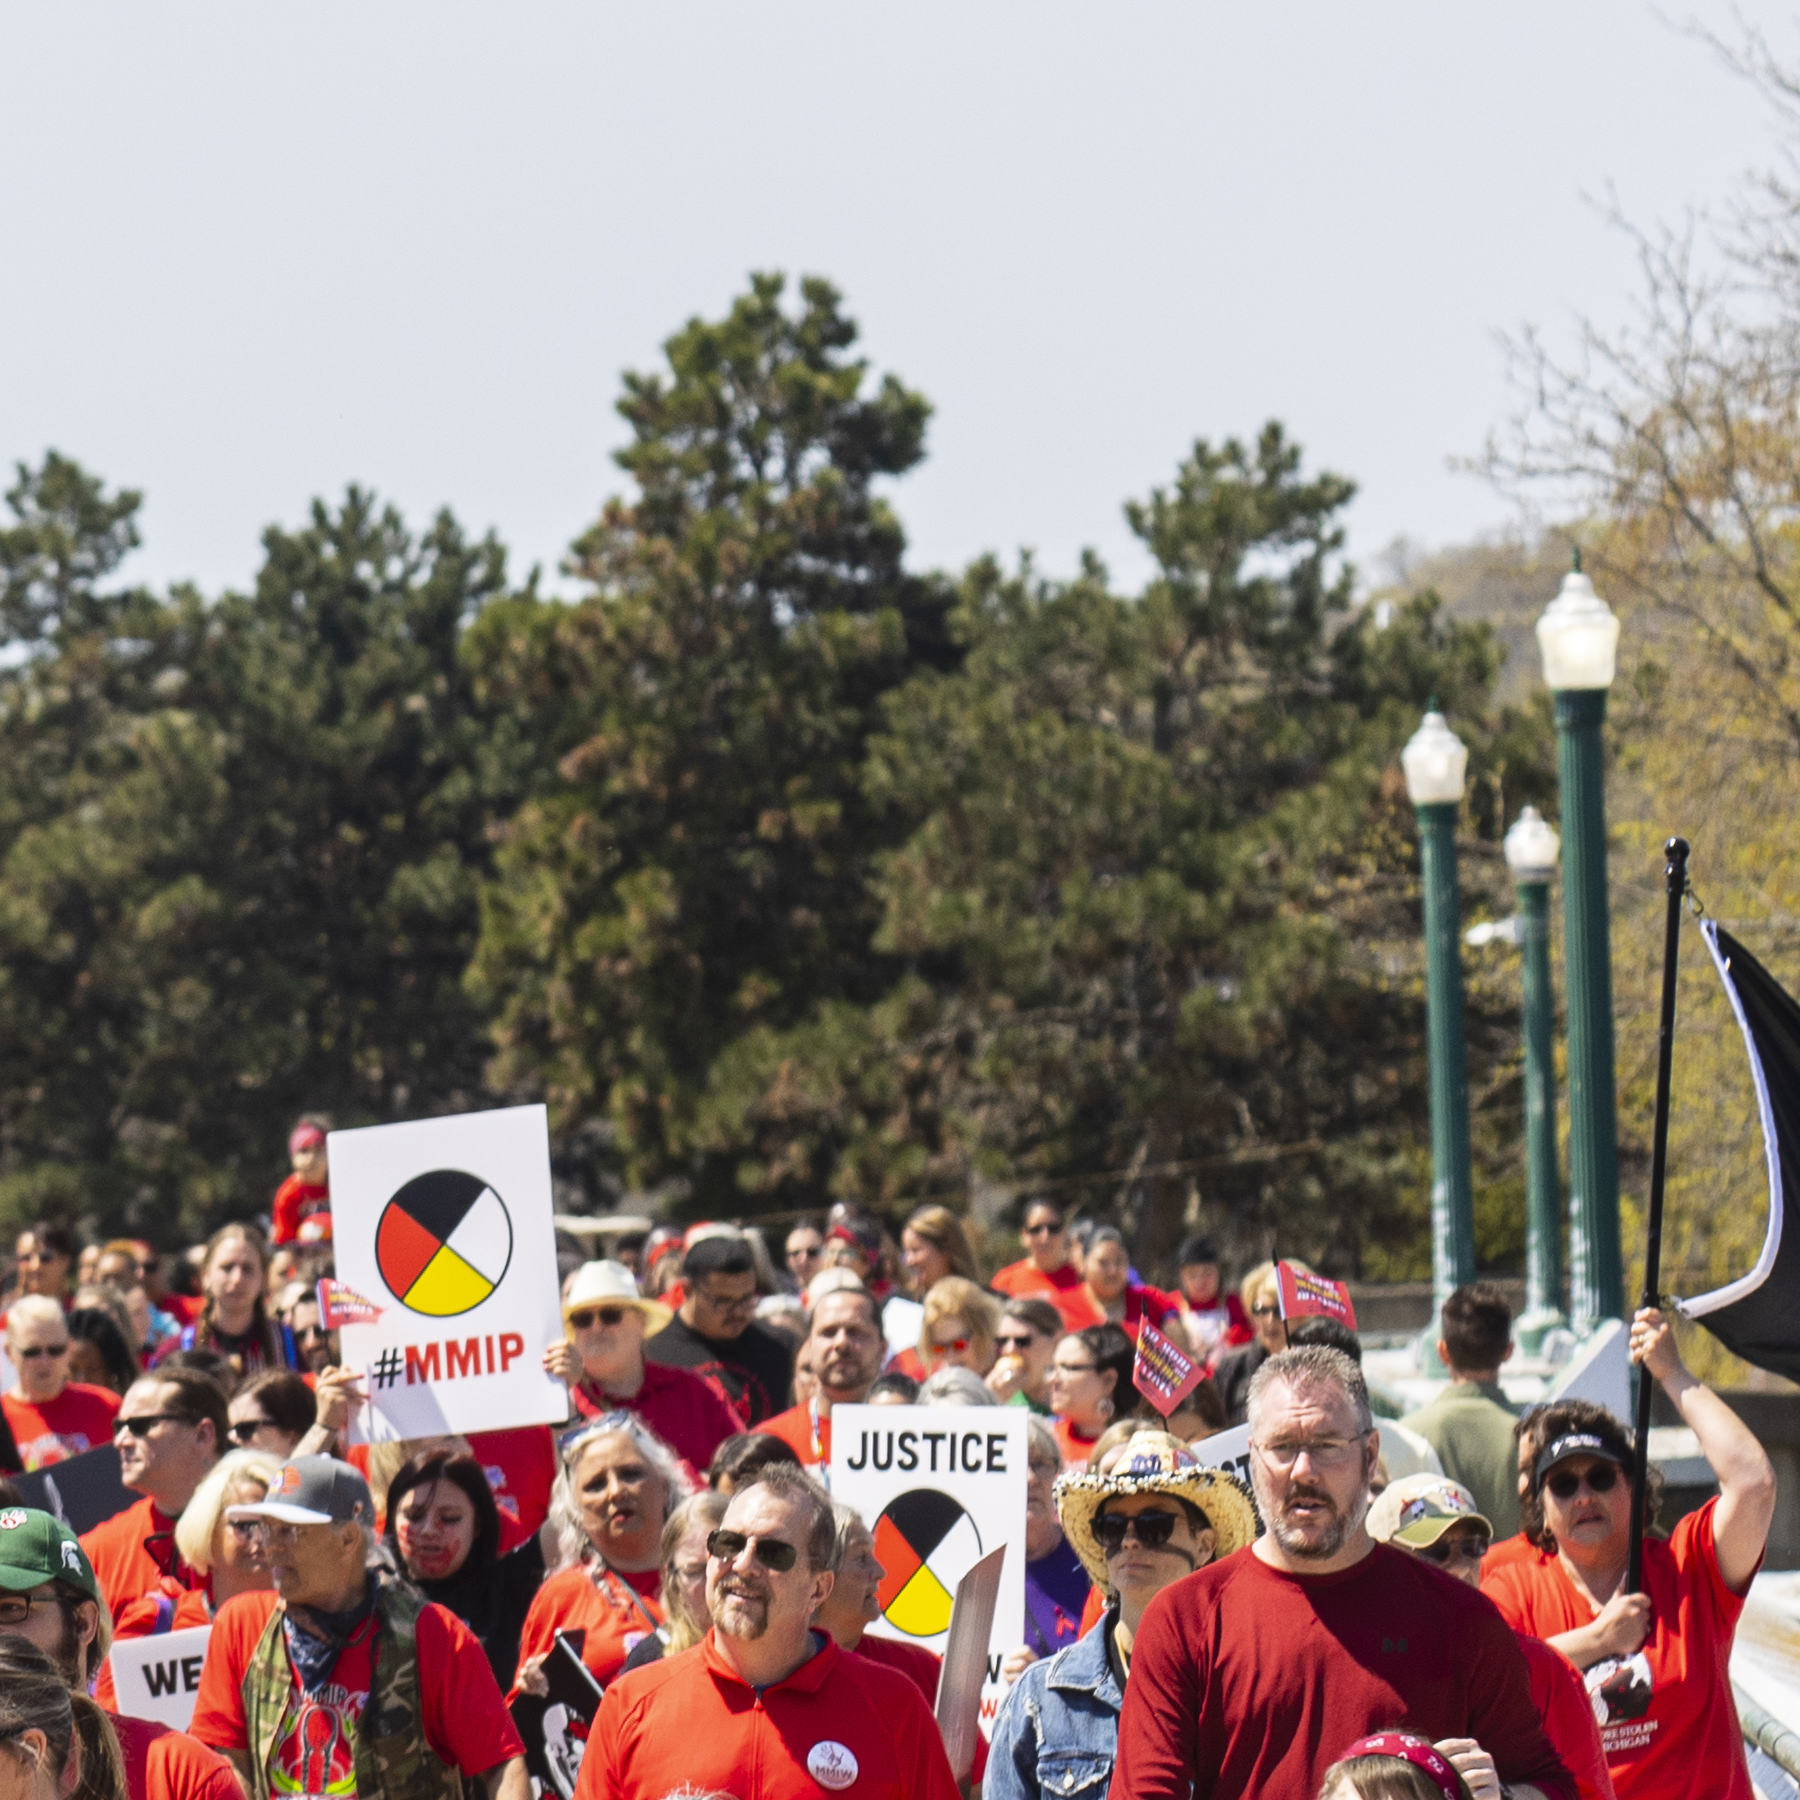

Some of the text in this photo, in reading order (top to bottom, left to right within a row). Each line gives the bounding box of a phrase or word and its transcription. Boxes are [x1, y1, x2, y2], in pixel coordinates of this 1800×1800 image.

[372, 1331, 525, 1391] #MMIP
[847, 1431, 1008, 1474] JUSTICE
[142, 1656, 204, 1698] WE
[815, 1765, 853, 1779] MMIW
